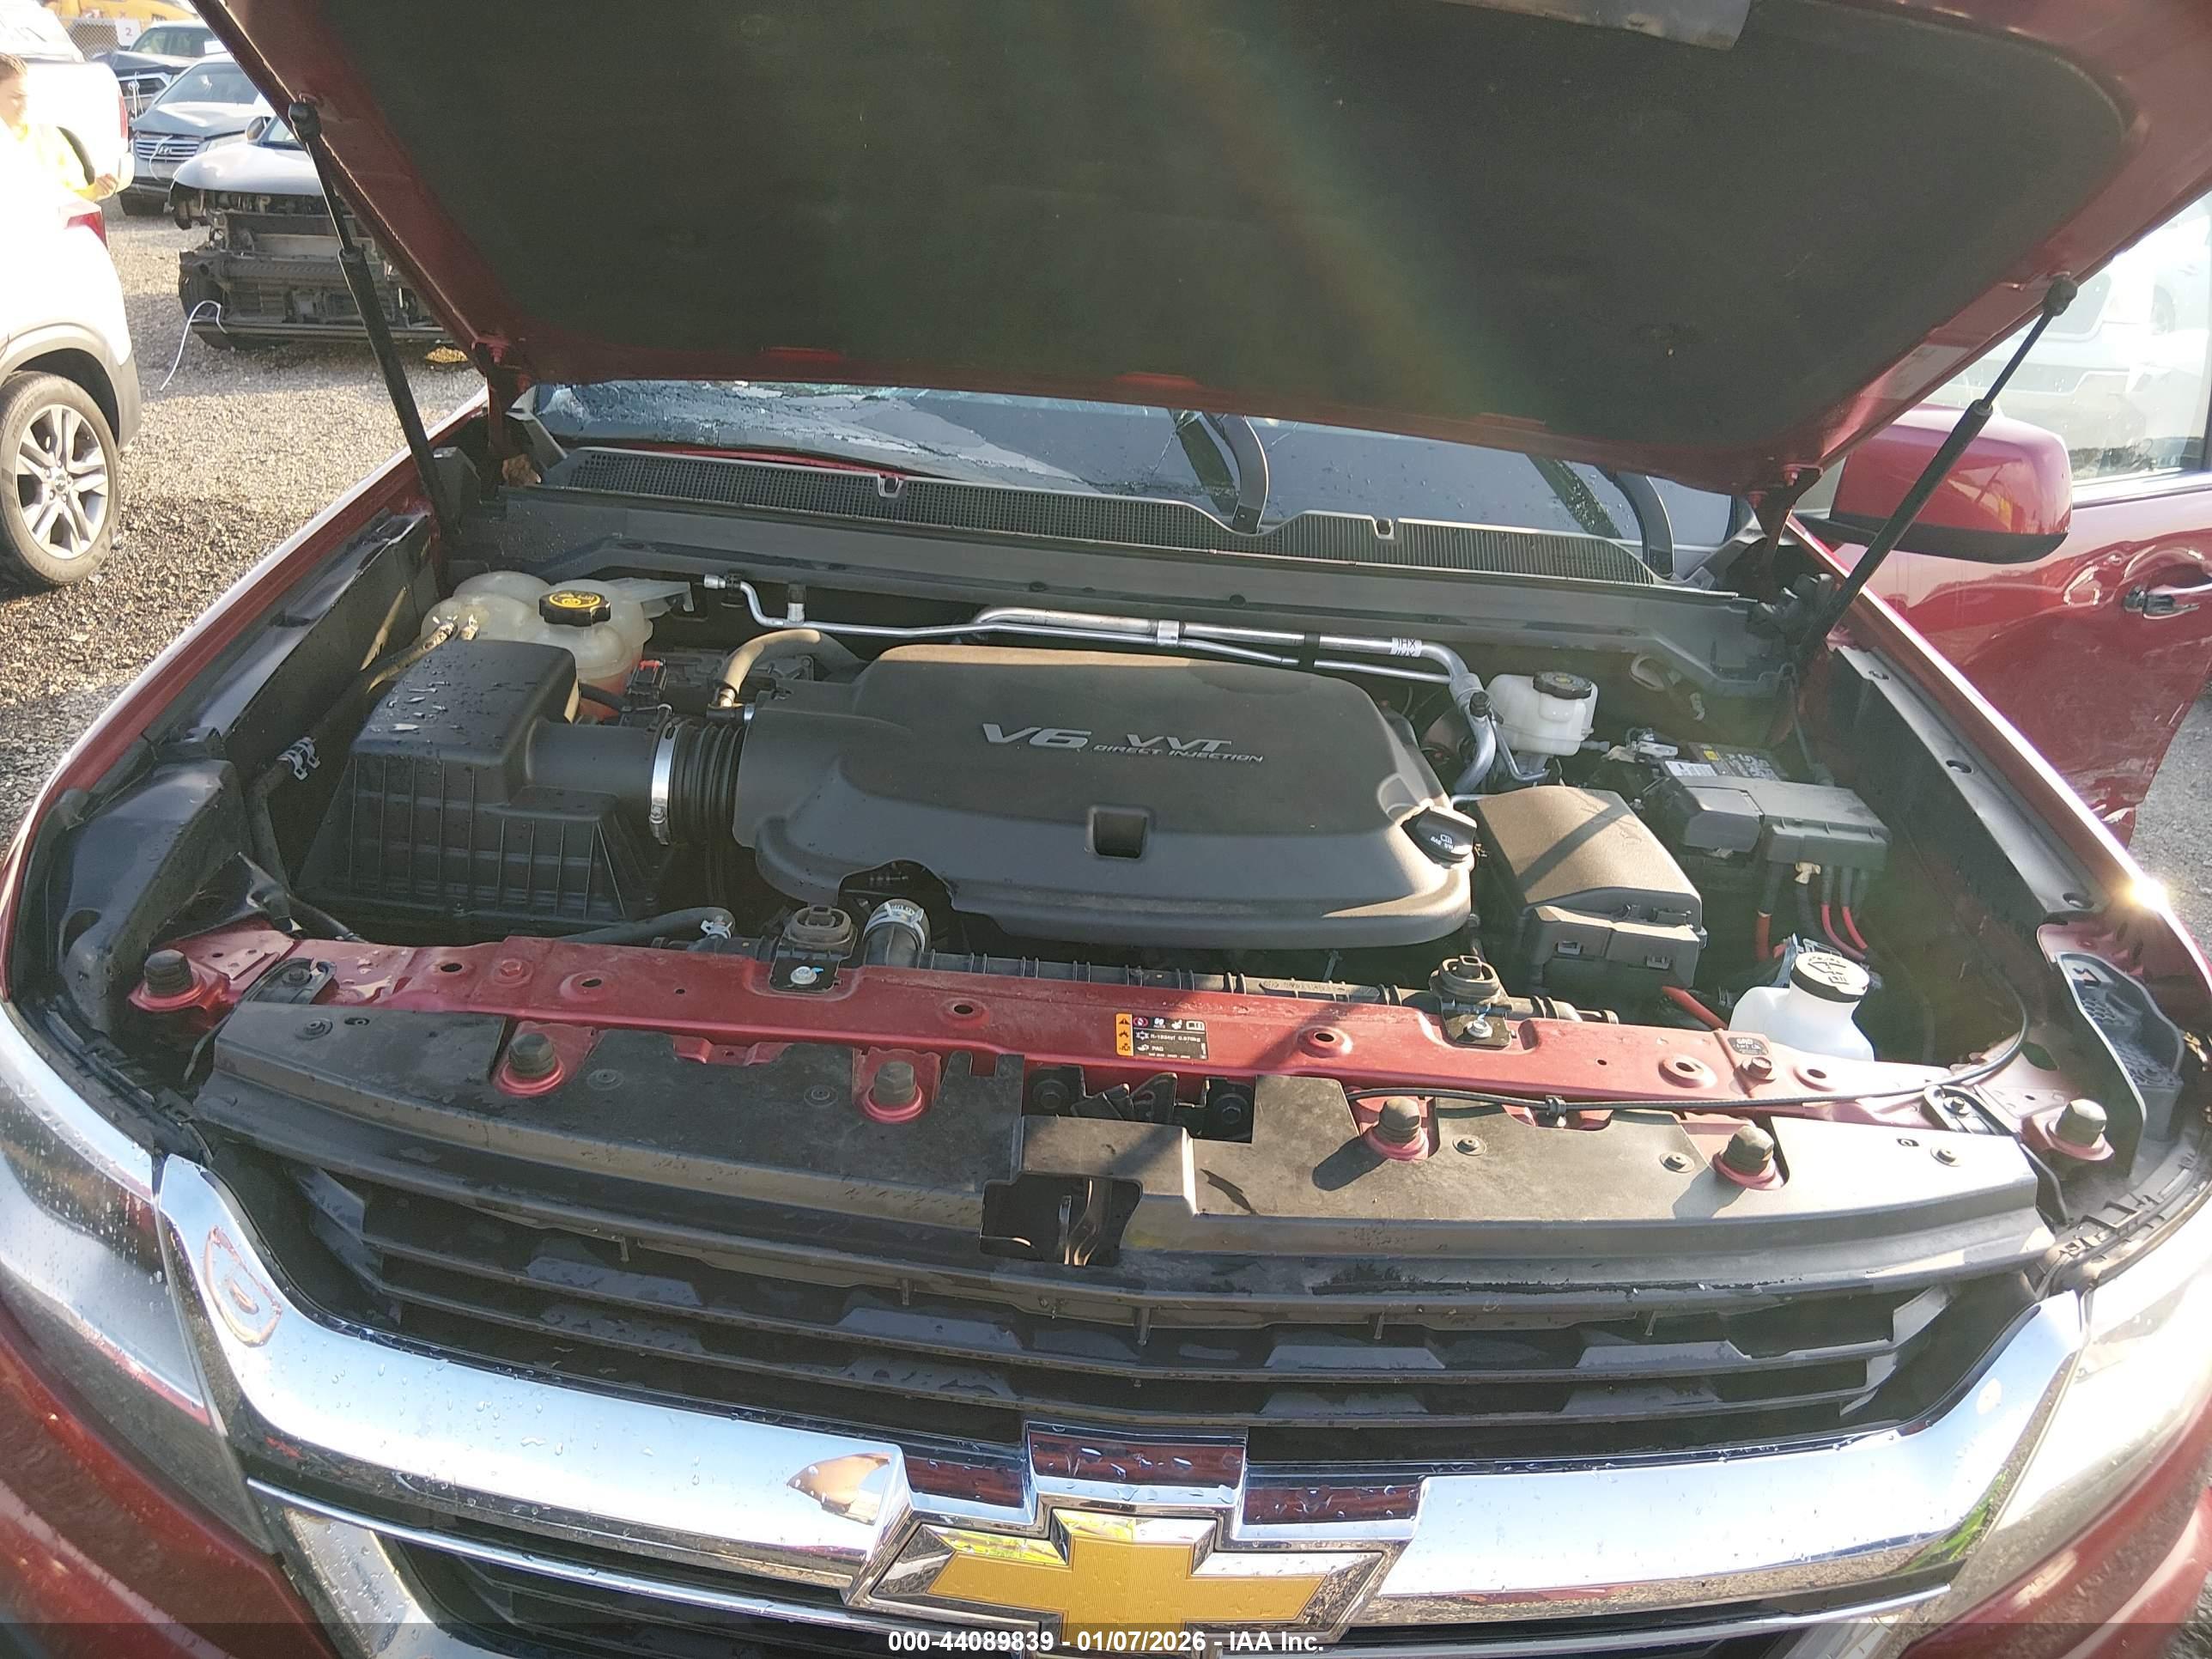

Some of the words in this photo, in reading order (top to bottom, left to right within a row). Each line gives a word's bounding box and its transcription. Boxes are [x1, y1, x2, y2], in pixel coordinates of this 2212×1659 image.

[982, 723, 1092, 749] V6
[1126, 733, 1232, 753] VVT
[1093, 744, 1163, 756] DIRECT
[1168, 749, 1264, 763] INJECTION
